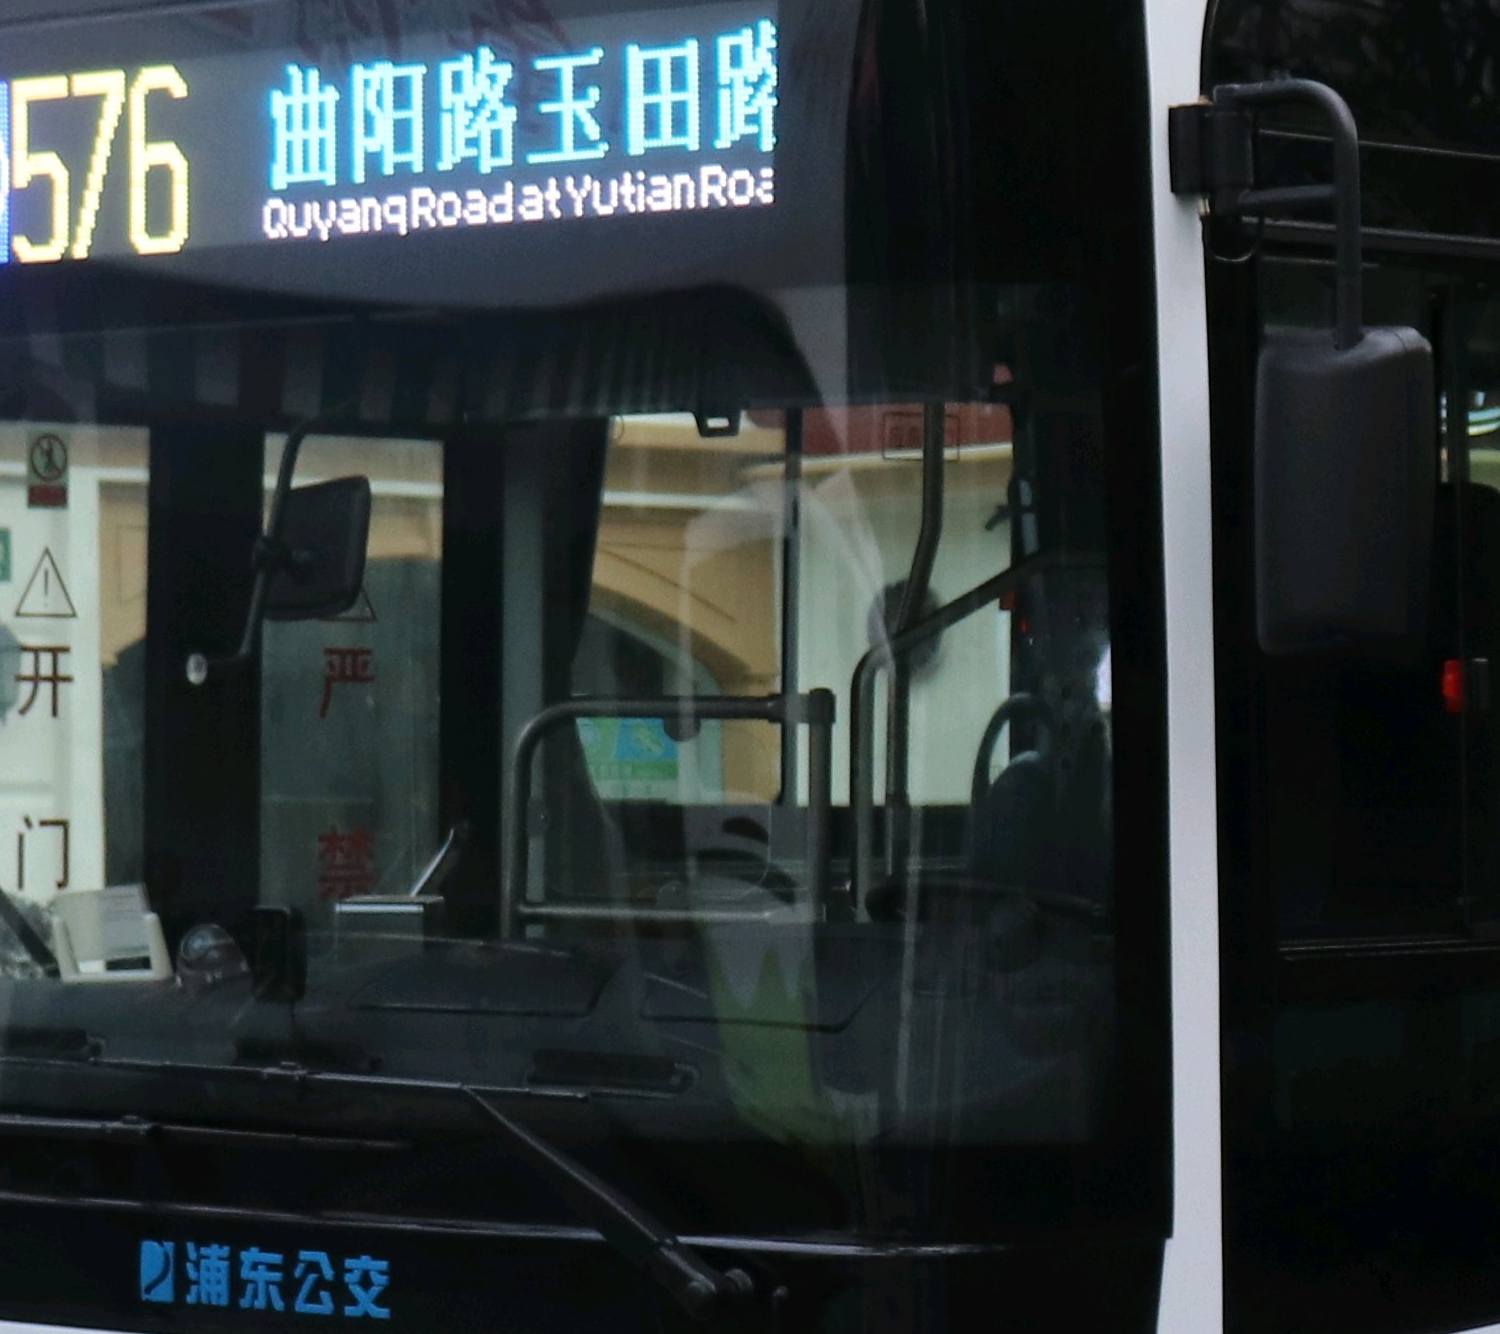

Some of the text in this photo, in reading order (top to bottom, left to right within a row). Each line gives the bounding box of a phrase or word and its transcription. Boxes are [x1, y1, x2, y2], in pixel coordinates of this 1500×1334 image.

[11, 64, 189, 264] 576
[268, 17, 778, 191] 曲阳路玉田路
[411, 180, 515, 229] Road
[517, 177, 562, 223] at
[565, 168, 695, 219] Yutian
[186, 1241, 391, 1319] 浦东公交
